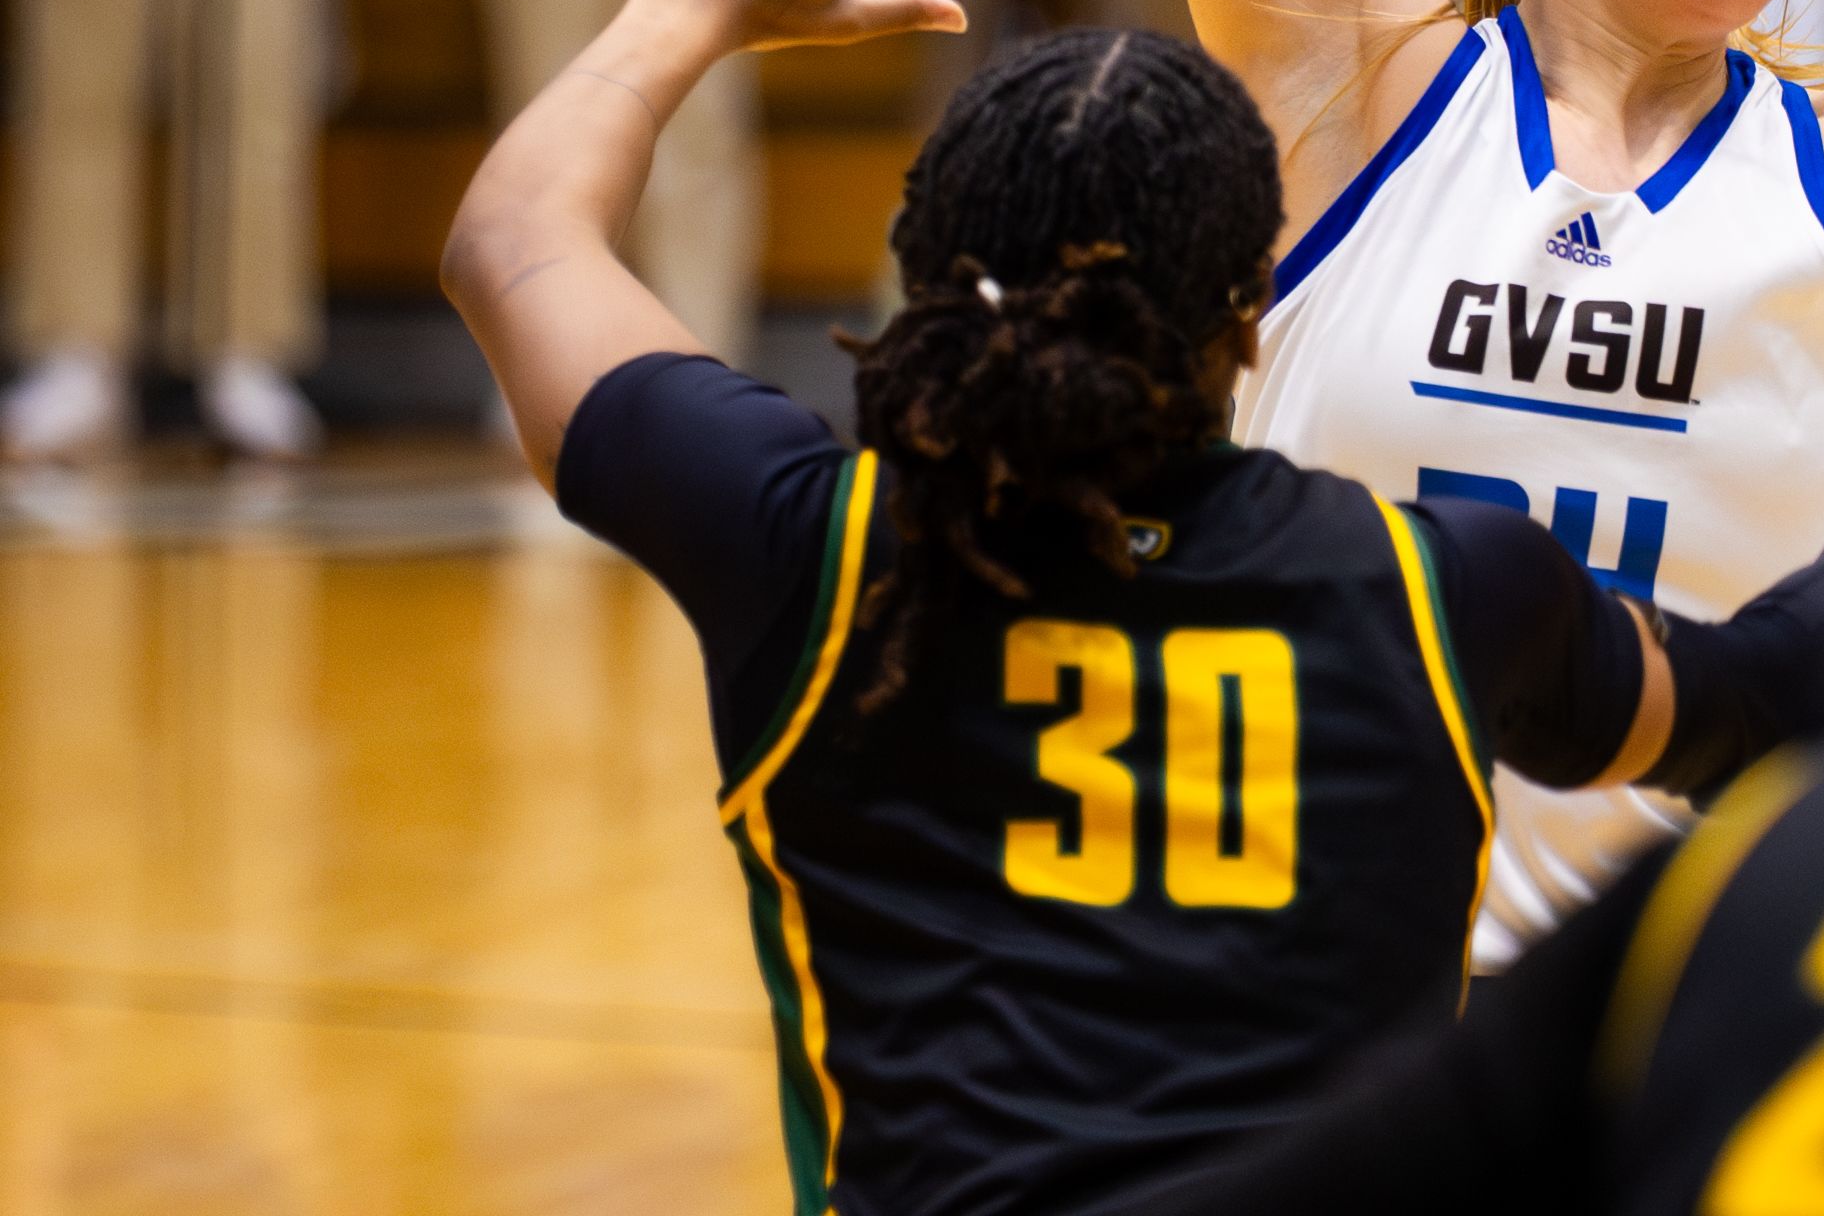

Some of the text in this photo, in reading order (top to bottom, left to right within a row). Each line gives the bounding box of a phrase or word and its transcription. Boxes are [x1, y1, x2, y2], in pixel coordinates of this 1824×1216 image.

[1545, 238, 1612, 268] adidas
[1427, 278, 1705, 404] GVSU
[1002, 619, 1297, 910] 30
